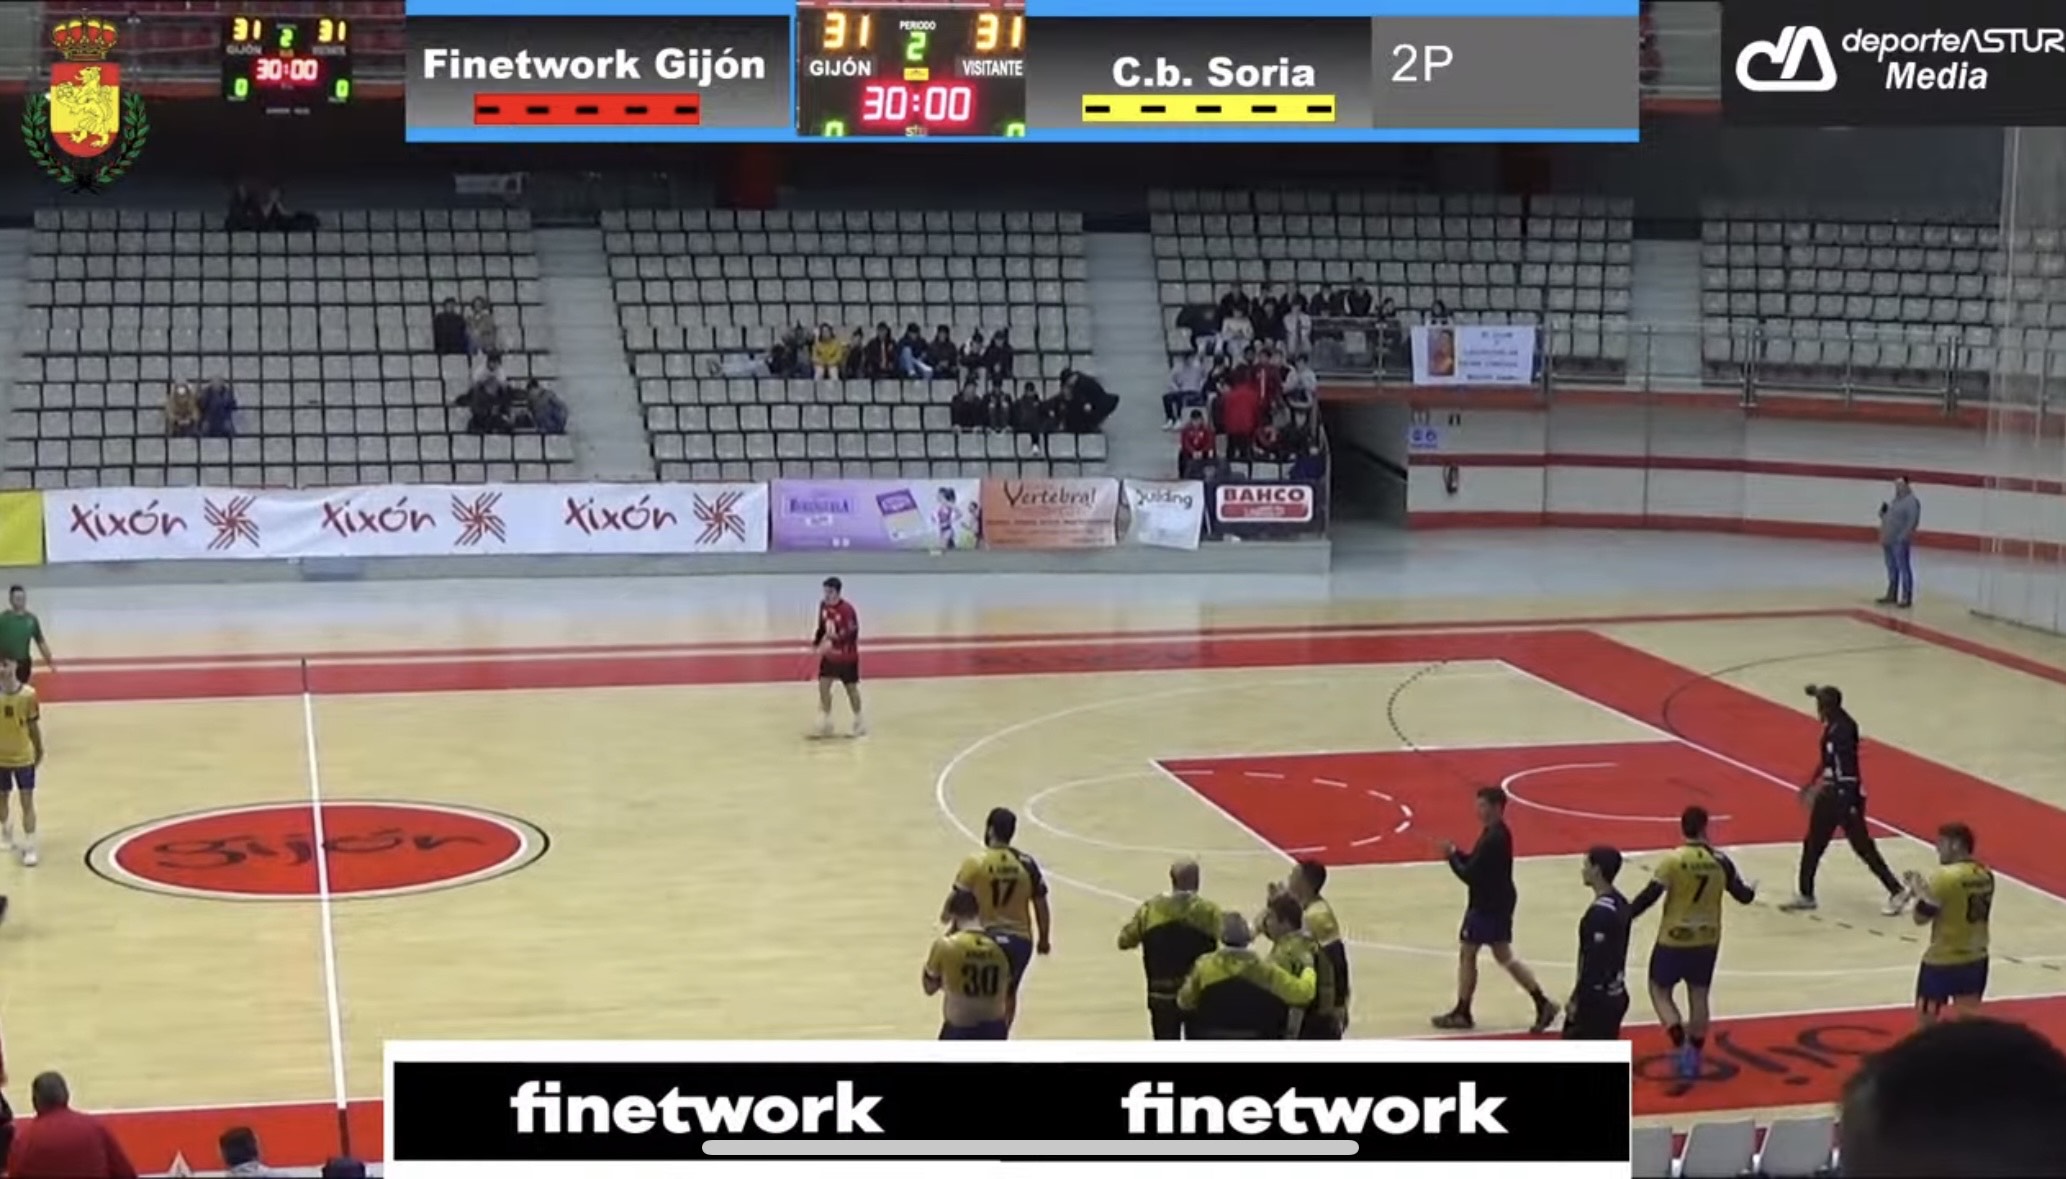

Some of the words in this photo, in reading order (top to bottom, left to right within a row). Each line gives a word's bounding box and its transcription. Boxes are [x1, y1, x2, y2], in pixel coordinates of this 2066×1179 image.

[233, 18, 261, 41] 31
[319, 19, 346, 42] 31
[823, 12, 870, 48] 31
[899, 20, 937, 31] PERIODO
[976, 13, 1023, 49] 31
[280, 28, 293, 47] 2
[906, 31, 926, 60] 2
[256, 58, 319, 80] 30:00
[808, 56, 872, 76] GIJÓN
[962, 59, 1024, 77] VISITANTE
[235, 78, 248, 97] 0
[336, 79, 349, 98] 0
[862, 85, 972, 121] 30:00
[1223, 487, 1306, 502] BAHCO
[990, 877, 1019, 908] 17
[1692, 873, 1709, 903] 7
[961, 963, 999, 998] 30
